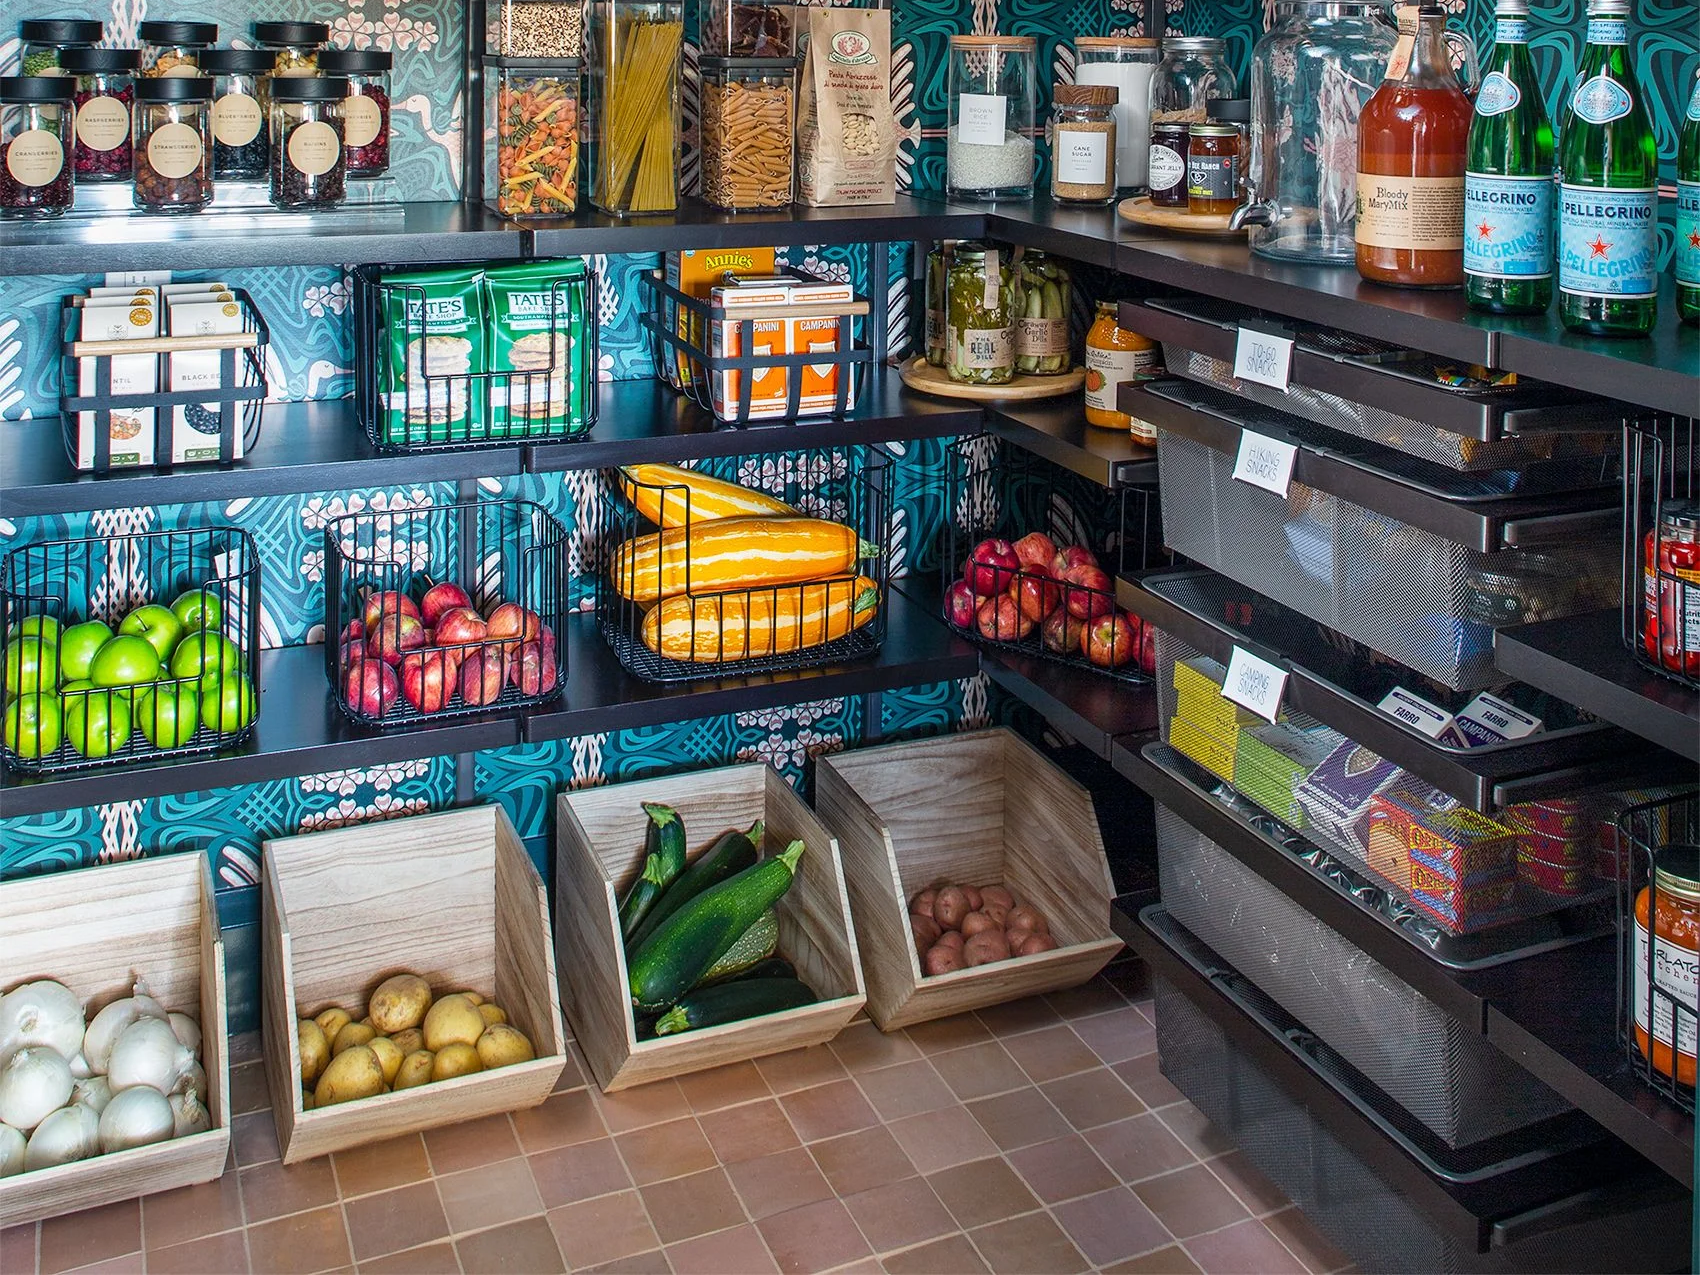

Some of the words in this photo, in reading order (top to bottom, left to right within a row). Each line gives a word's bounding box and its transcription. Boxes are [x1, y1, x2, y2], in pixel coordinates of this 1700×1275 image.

[1376, 187, 1408, 202] Bloody
[1466, 188, 1537, 205] ELLEGRINO
[1465, 230, 1537, 259] ELLEGRINO
[705, 251, 754, 271] Annie's
[408, 299, 462, 315] TATE'S
[510, 292, 564, 307] TATES
[734, 321, 780, 333] CPANINI
[800, 319, 841, 331] CAMPANIN
[1018, 319, 1048, 329] Caraway
[1024, 326, 1048, 336] Garlic
[970, 342, 996, 354] REAL
[1032, 335, 1048, 343] Dills
[1251, 342, 1277, 361] TO-GO
[1247, 357, 1278, 378] SNACKS
[1249, 445, 1280, 467] HIKING
[1246, 459, 1278, 482] SNACKS
[1240, 662, 1270, 690] CAMPING
[1238, 677, 1267, 706] SNACKS
[1393, 706, 1420, 725] FARRO
[1481, 710, 1509, 728] FARRO
[1458, 719, 1503, 745] CAMPANIN
[1641, 939, 1699, 975] TRLATO
[1643, 953, 1699, 985] ktchen
